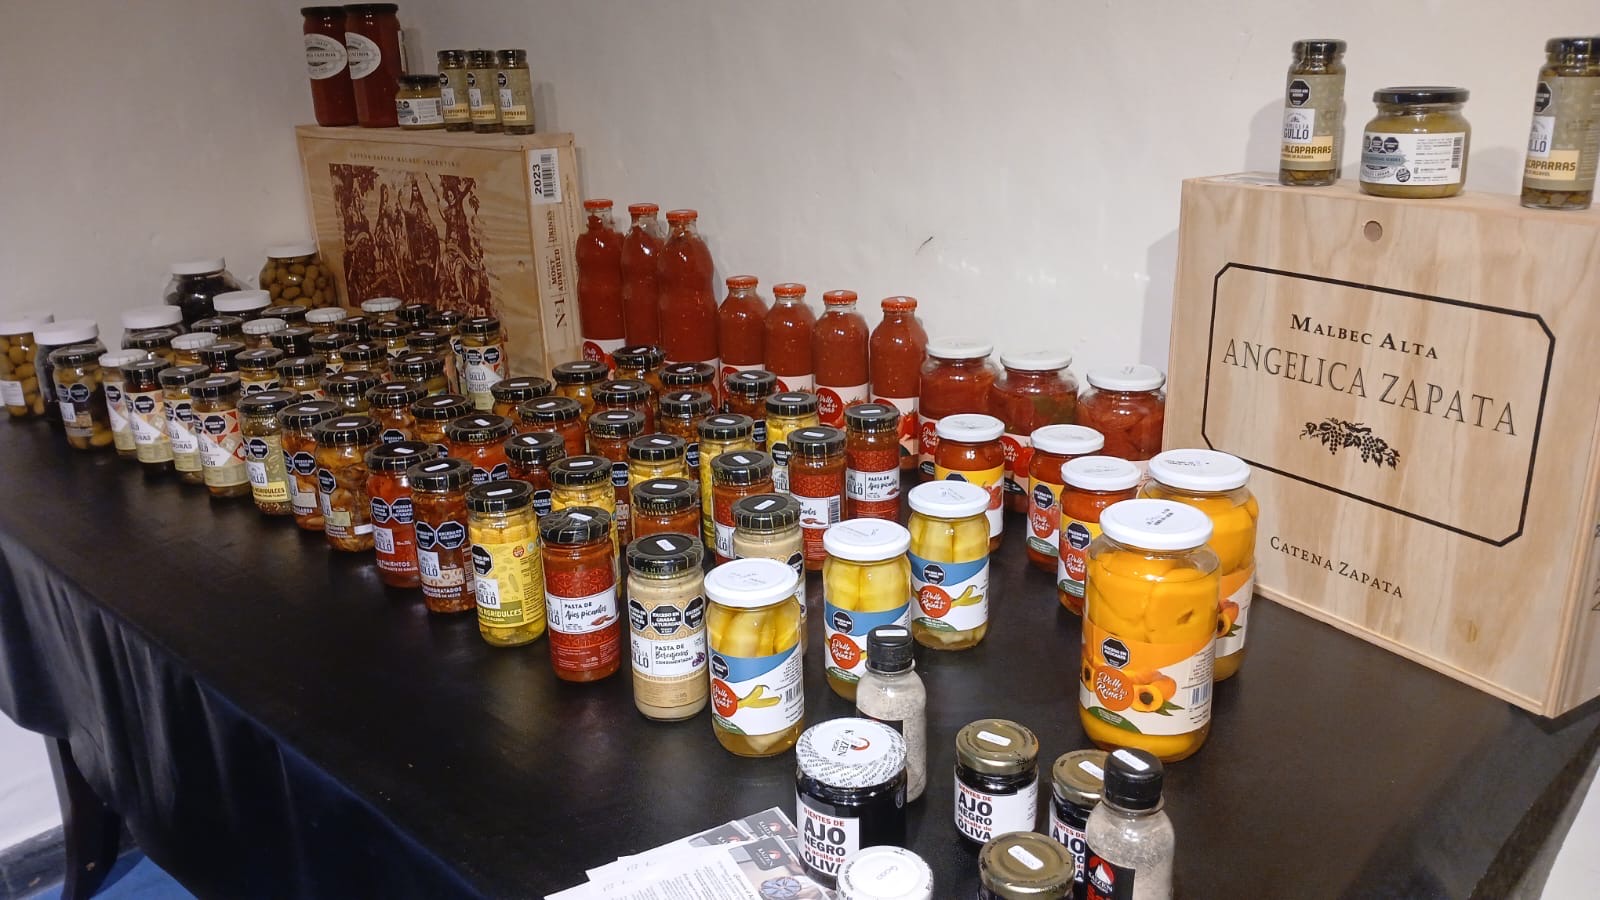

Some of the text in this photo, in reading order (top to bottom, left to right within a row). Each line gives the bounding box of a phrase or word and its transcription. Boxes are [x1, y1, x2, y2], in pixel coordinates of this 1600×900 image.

[533, 163, 541, 195] 2023
[1222, 337, 1518, 437] ANGELICA ZAPATA
[1269, 535, 1404, 600] CATENA ZAPATA
[484, 608, 522, 618] AGRIDULCES
[1096, 680, 1124, 701] Reinas
[1098, 671, 1122, 689] Valle
[958, 790, 993, 817] AJO
[958, 804, 993, 826] NEGRO
[804, 816, 846, 845] AJO
[833, 819, 845, 827] DE
[958, 818, 992, 841] OLIVA
[804, 832, 846, 857] NEGRO
[1052, 825, 1085, 854] AJO
[1075, 831, 1086, 840] DE
